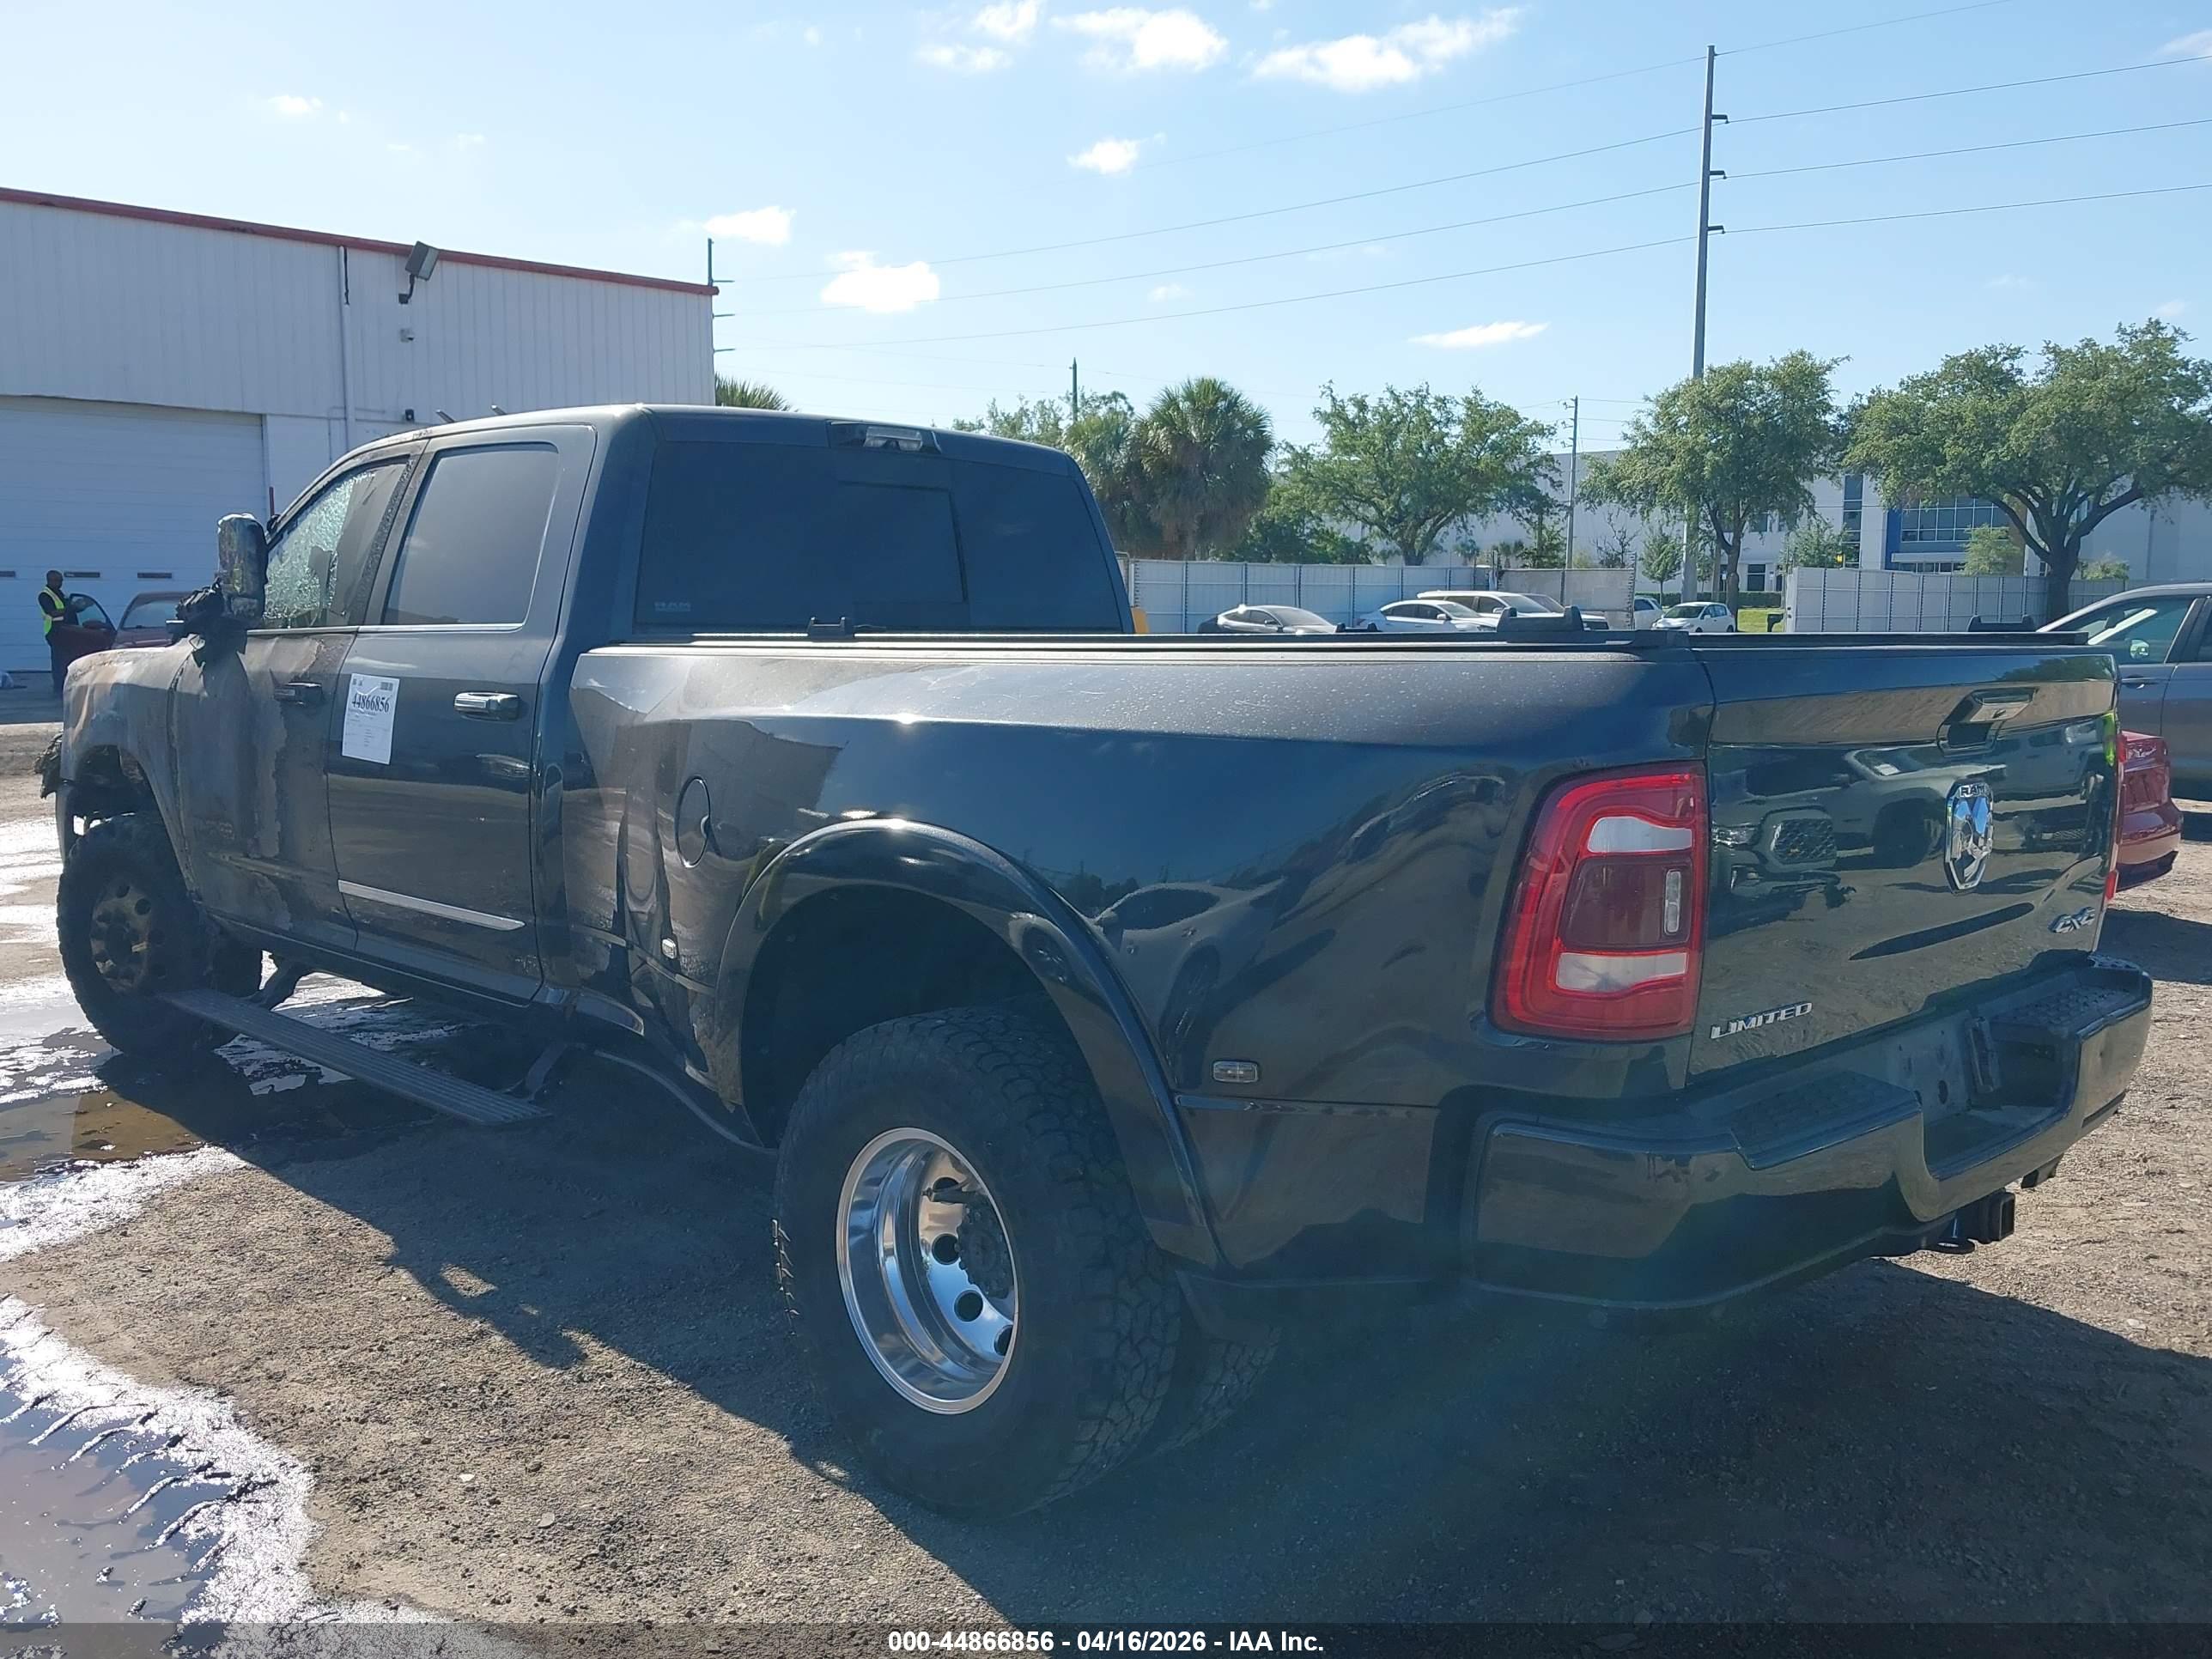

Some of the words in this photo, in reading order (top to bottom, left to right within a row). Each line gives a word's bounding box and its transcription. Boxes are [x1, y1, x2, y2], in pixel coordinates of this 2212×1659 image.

[352, 692, 390, 713] 44866856
[1959, 783, 1986, 797] RAM
[1711, 1002, 1813, 1039] LIMITED
